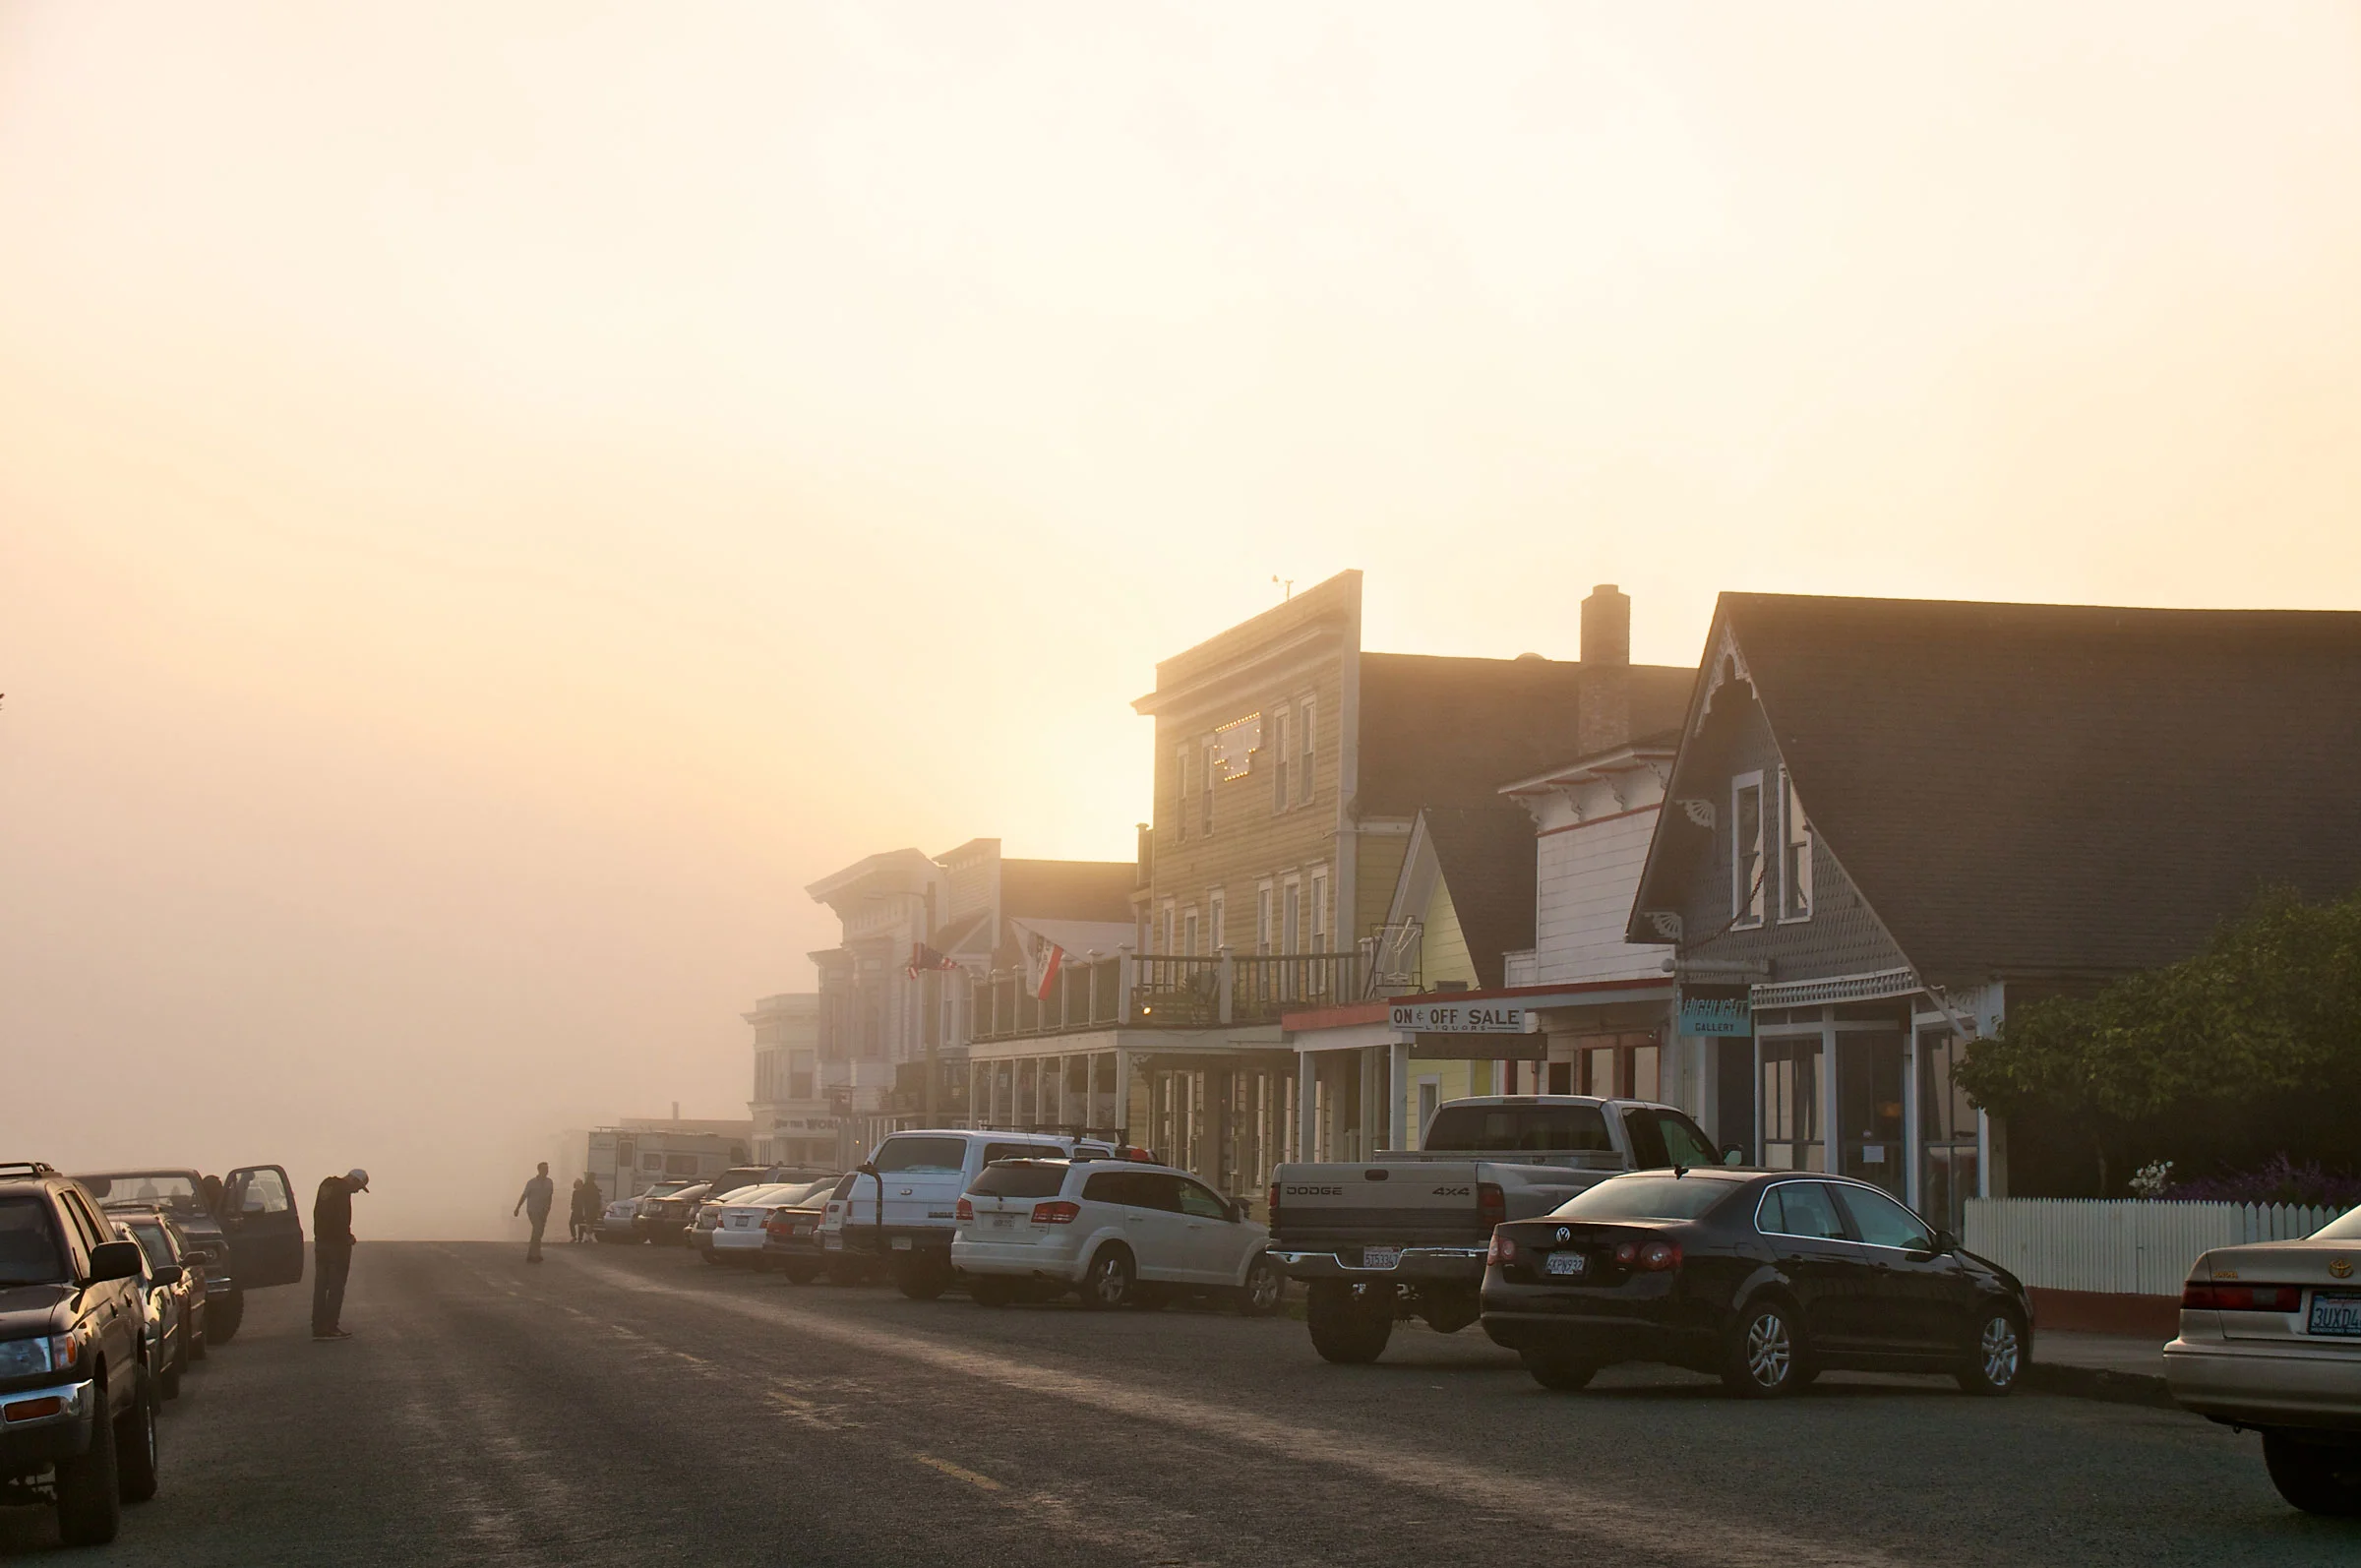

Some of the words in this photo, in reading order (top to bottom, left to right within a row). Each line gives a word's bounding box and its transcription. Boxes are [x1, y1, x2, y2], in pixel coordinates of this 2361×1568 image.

[1393, 1008, 1413, 1024] ON
[1416, 1008, 1423, 1022] &
[1429, 1008, 1459, 1024] OFF
[1468, 1008, 1520, 1025] SALE
[1695, 1022, 1734, 1032] GALLERY
[1286, 1186, 1343, 1196] DODGE
[2314, 1307, 2361, 1327] 3UXD4
